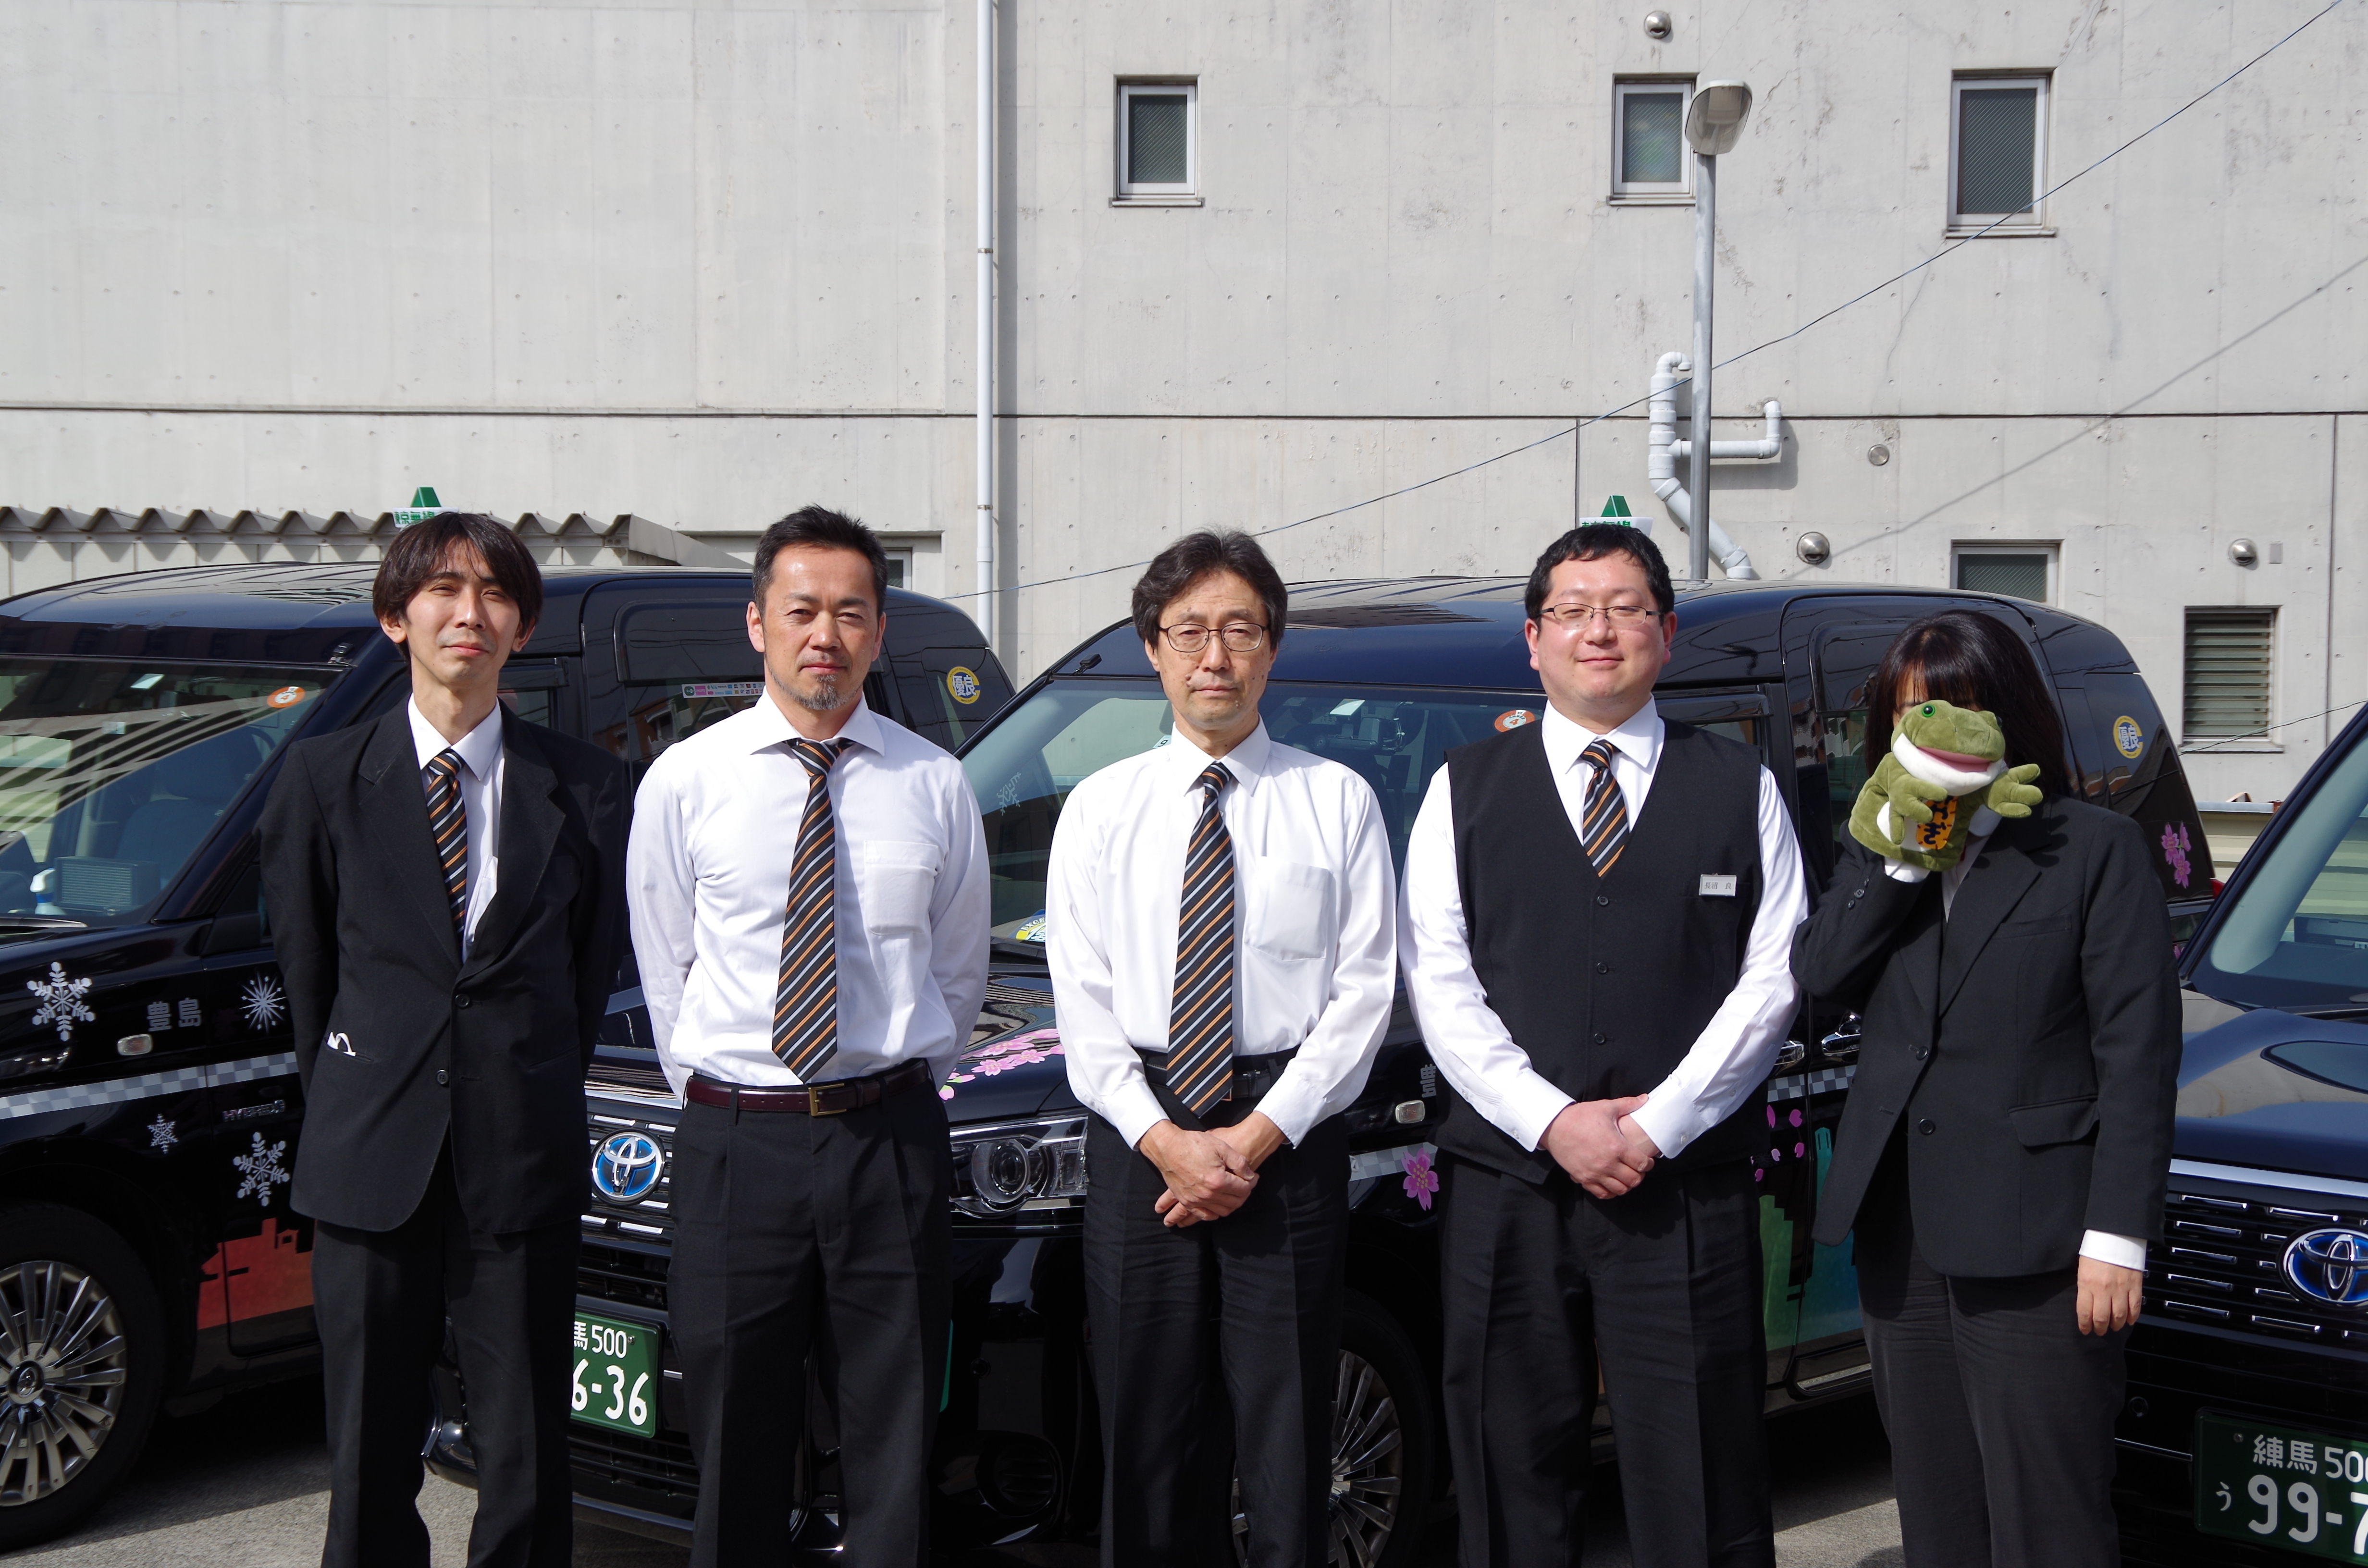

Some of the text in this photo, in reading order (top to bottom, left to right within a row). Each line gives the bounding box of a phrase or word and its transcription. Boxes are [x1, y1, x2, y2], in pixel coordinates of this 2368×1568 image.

[952, 674, 977, 697] 優良
[2118, 725, 2141, 750] 優良
[147, 997, 201, 1031] 豊島
[574, 1321, 627, 1359] 馬 500
[2253, 1434, 2368, 1483] 練馬 50
[2216, 1481, 2231, 1511] う
